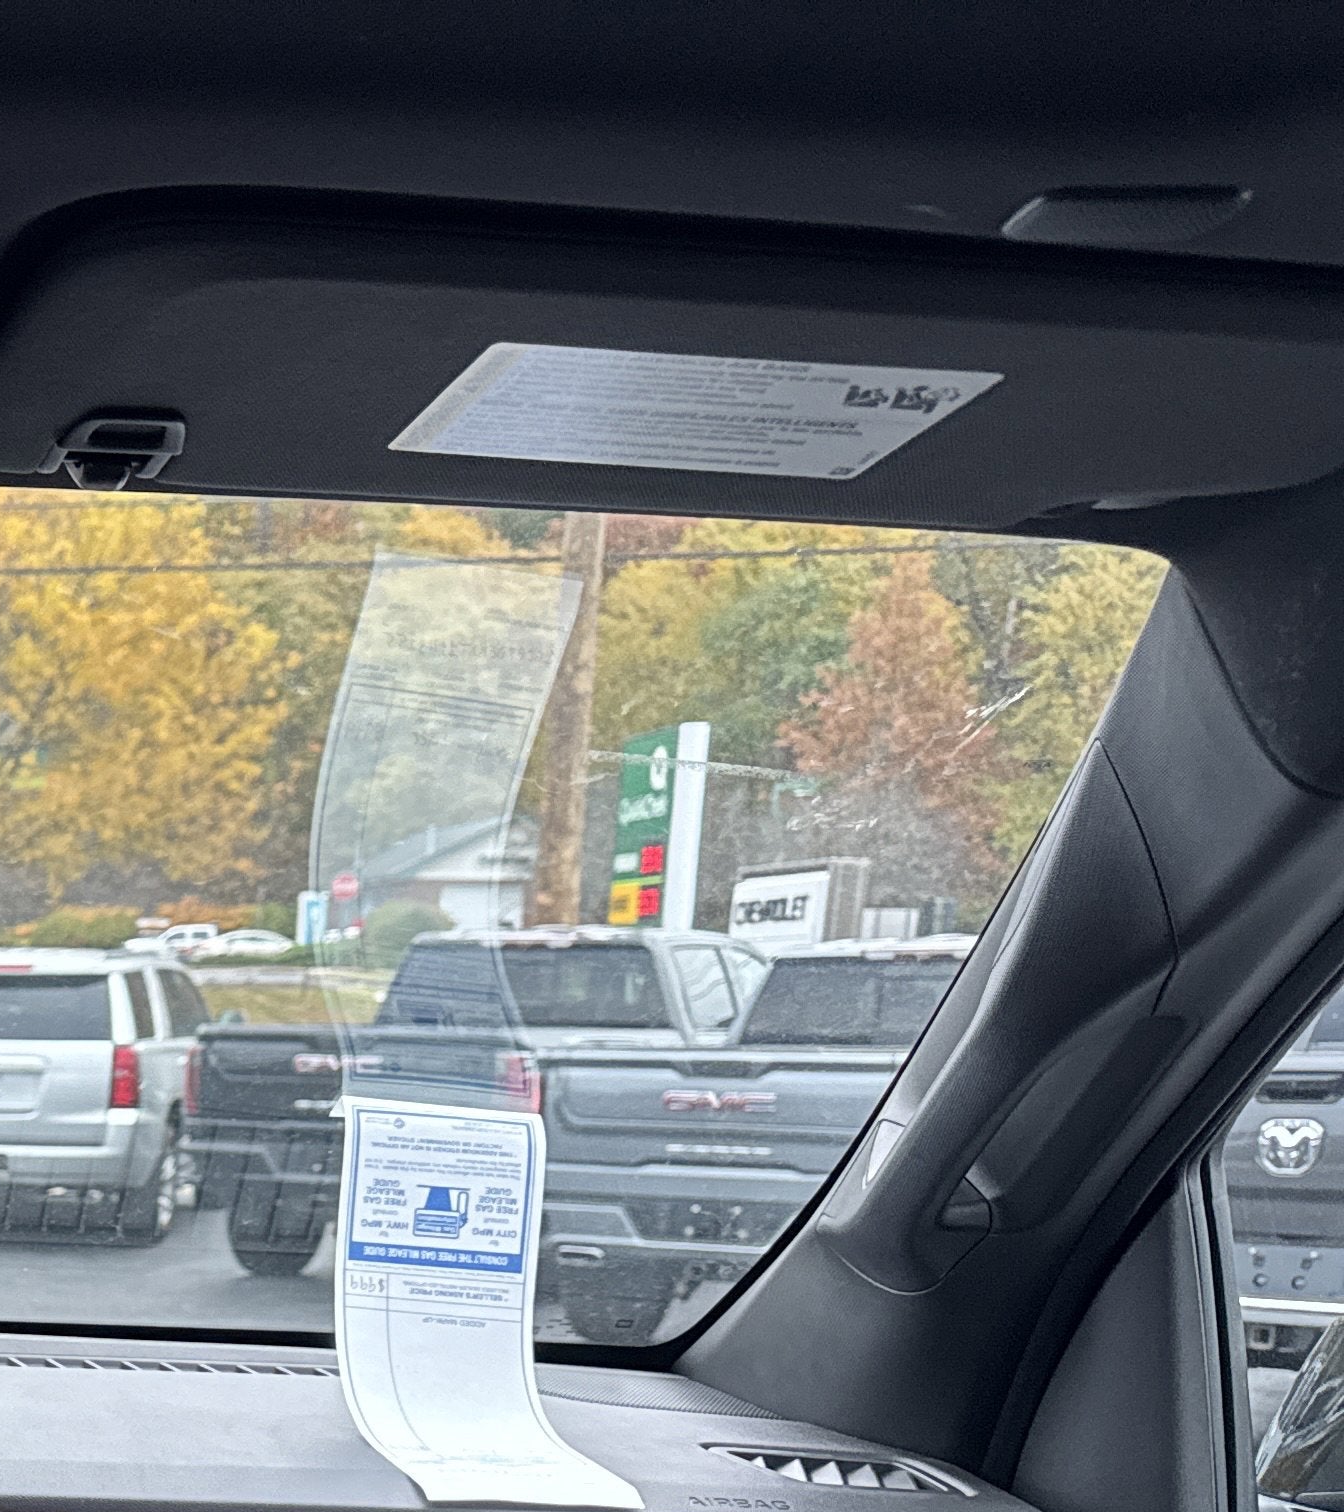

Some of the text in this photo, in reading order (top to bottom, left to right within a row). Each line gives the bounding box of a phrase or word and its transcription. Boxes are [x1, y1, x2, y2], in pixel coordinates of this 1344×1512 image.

[662, 1089, 778, 1114] GMC
[373, 1178, 401, 1188] GUIDE
[366, 1186, 406, 1197] MILEAGE
[485, 1187, 513, 1196] GUIDE
[478, 1195, 517, 1206] MILEAGE
[475, 1204, 519, 1215] FREE GAS
[360, 1219, 383, 1229] MPG
[472, 1228, 518, 1239] CITY MPG
[362, 1245, 508, 1266] CONSULT THE FREE GAS MILEAGE GUIDE
[408, 1287, 433, 1299] PRICE
[433, 1289, 464, 1300] ASKING
[689, 1496, 791, 1511] AIRBAG
